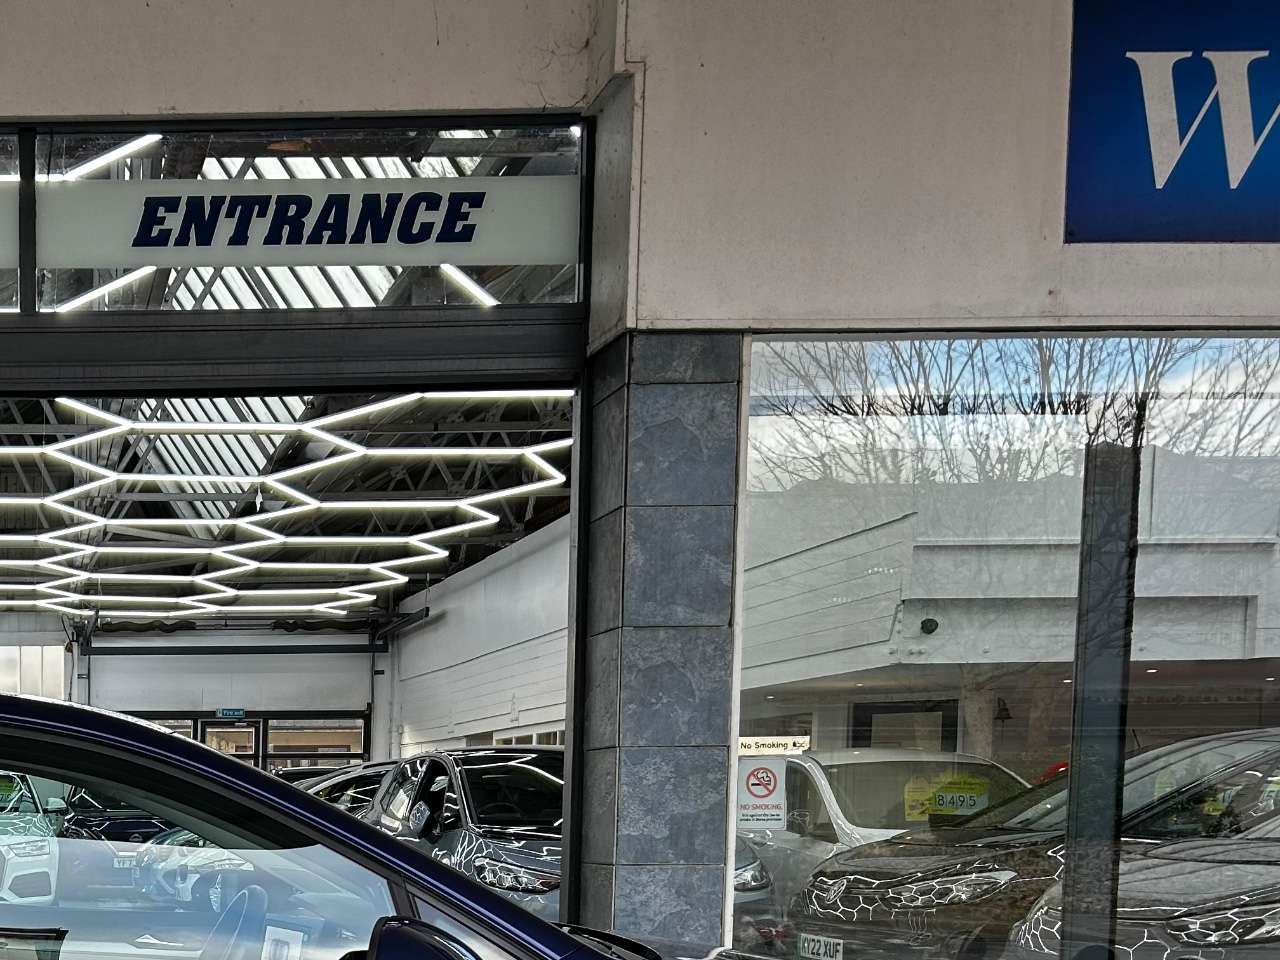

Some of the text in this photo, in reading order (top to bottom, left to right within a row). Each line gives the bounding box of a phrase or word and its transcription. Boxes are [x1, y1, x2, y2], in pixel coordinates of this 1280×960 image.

[1125, 50, 1280, 190] W
[131, 191, 487, 247] ENTRANCE
[754, 741, 789, 750] Smoking
[937, 794, 977, 808] 8495
[801, 936, 841, 960] KY22 XUF
